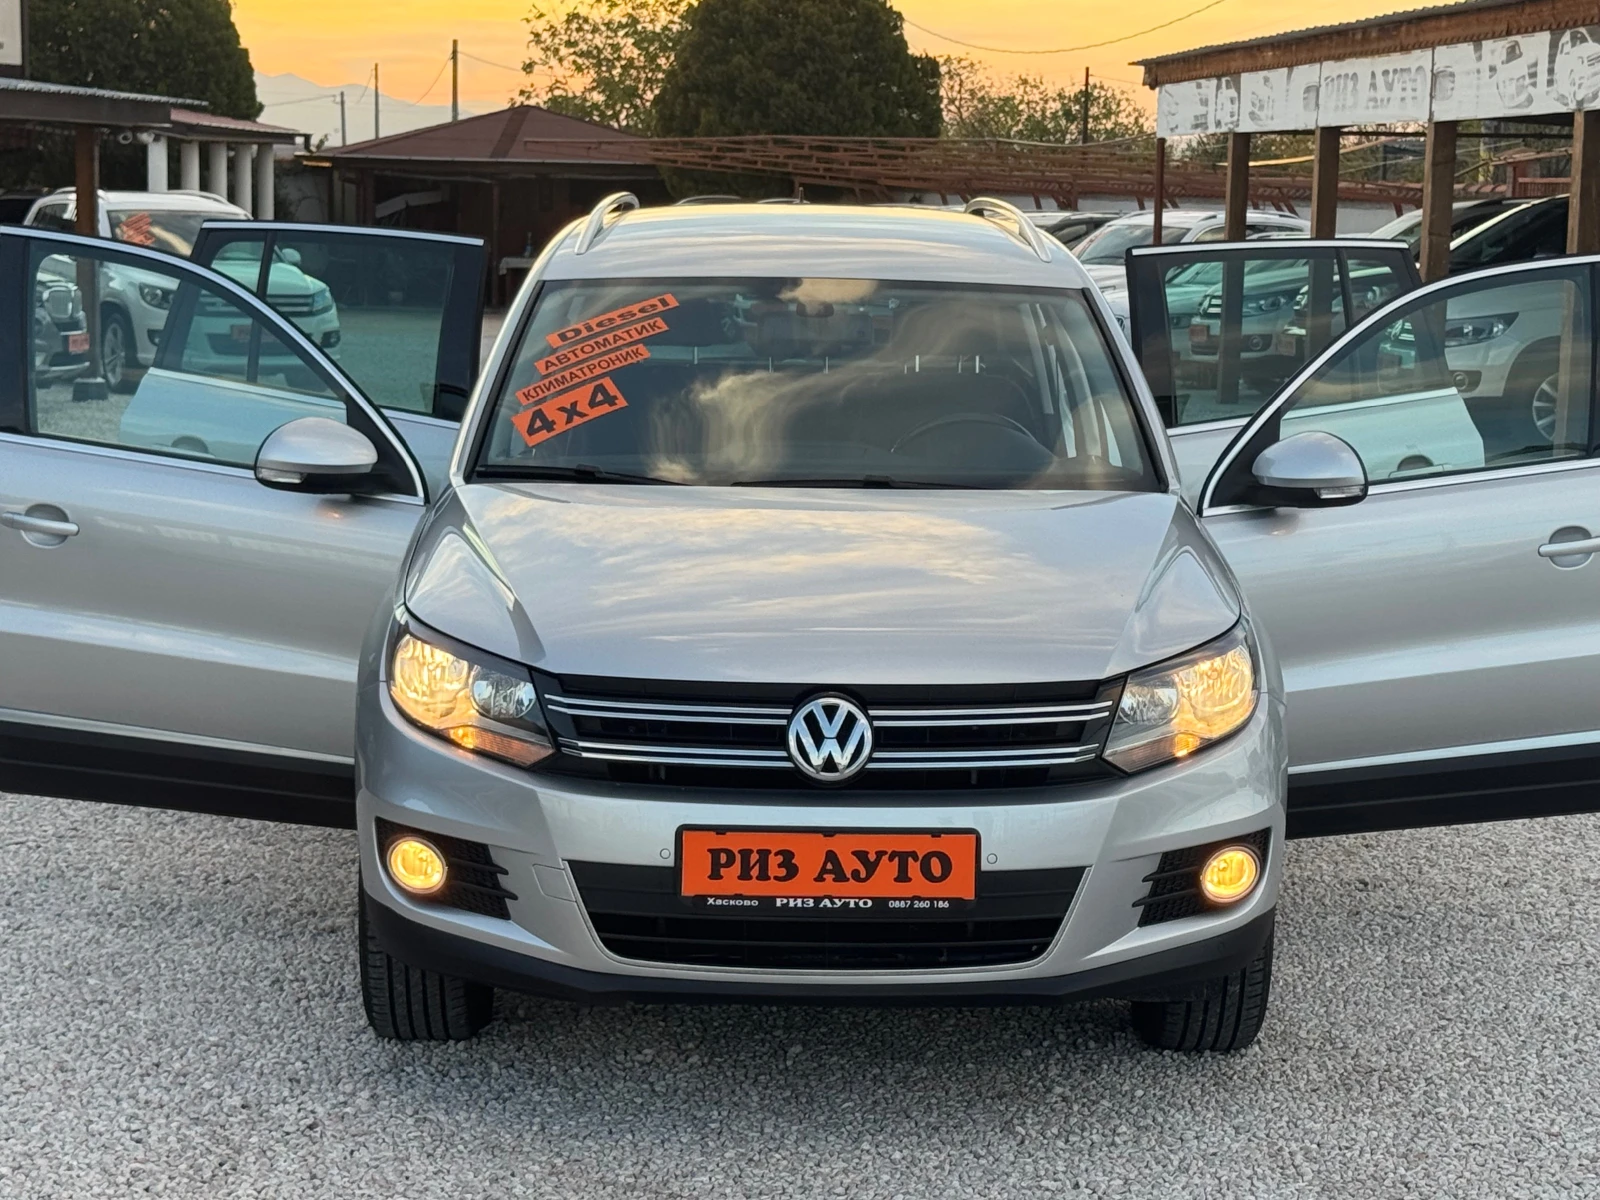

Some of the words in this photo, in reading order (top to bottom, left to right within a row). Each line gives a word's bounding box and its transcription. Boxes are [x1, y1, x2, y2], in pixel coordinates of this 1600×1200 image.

[557, 298, 670, 343] Diesel
[544, 320, 662, 371] АВТОМАТИК
[522, 347, 644, 402] КЛИМАТРОНИК
[707, 848, 799, 882] РИЗ
[813, 849, 953, 884] АУТО
[707, 897, 759, 907] Хасково
[776, 898, 814, 908] РИЗ
[819, 898, 873, 909] АУТО
[888, 901, 911, 909] 0887
[913, 901, 931, 909] 260
[933, 901, 950, 909] 186
